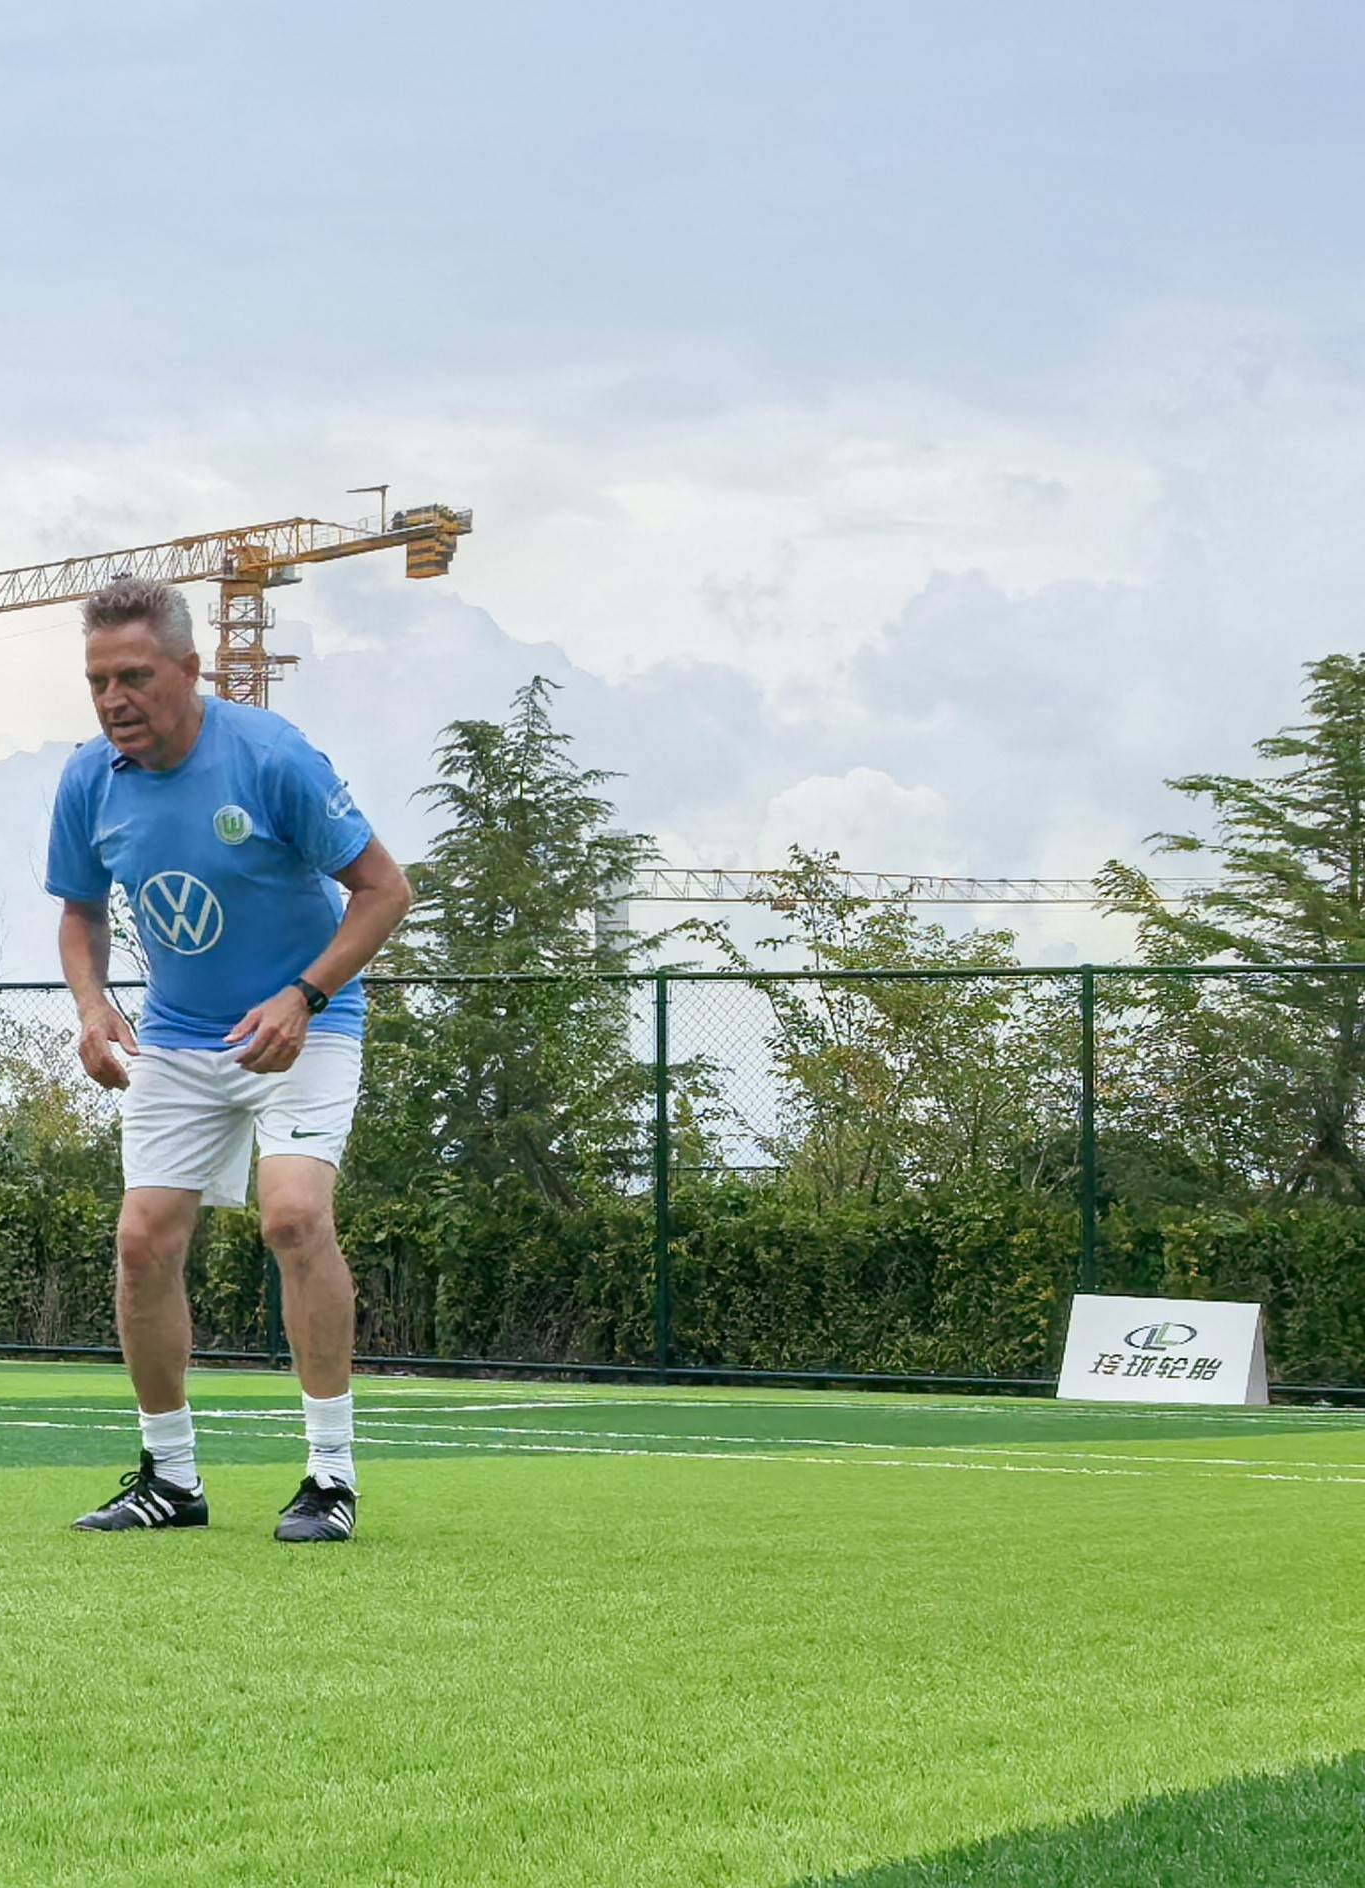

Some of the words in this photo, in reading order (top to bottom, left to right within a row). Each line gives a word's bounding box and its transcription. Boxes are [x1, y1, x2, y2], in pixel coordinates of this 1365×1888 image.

[140, 873, 222, 953] VW
[1088, 1352, 1223, 1381] 玲珑轮胎
